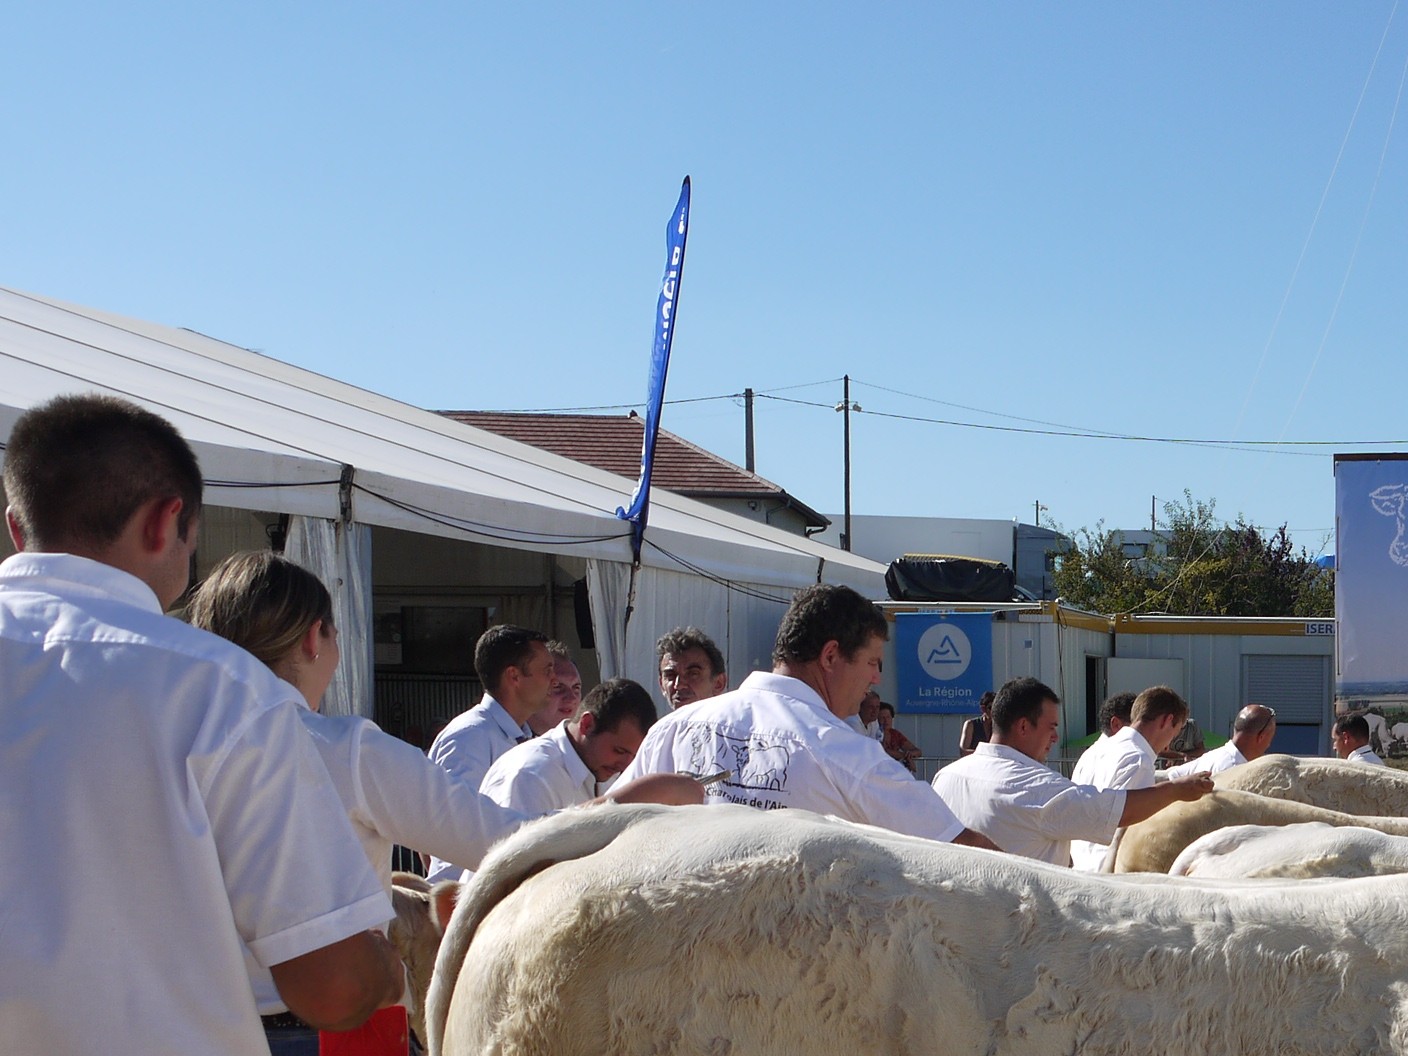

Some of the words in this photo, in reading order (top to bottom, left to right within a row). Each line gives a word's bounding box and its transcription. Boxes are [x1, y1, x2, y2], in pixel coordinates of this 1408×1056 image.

[1306, 623, 1335, 634] ISER
[919, 687, 932, 697] La
[933, 685, 972, 699] Région
[750, 797, 763, 809] de
